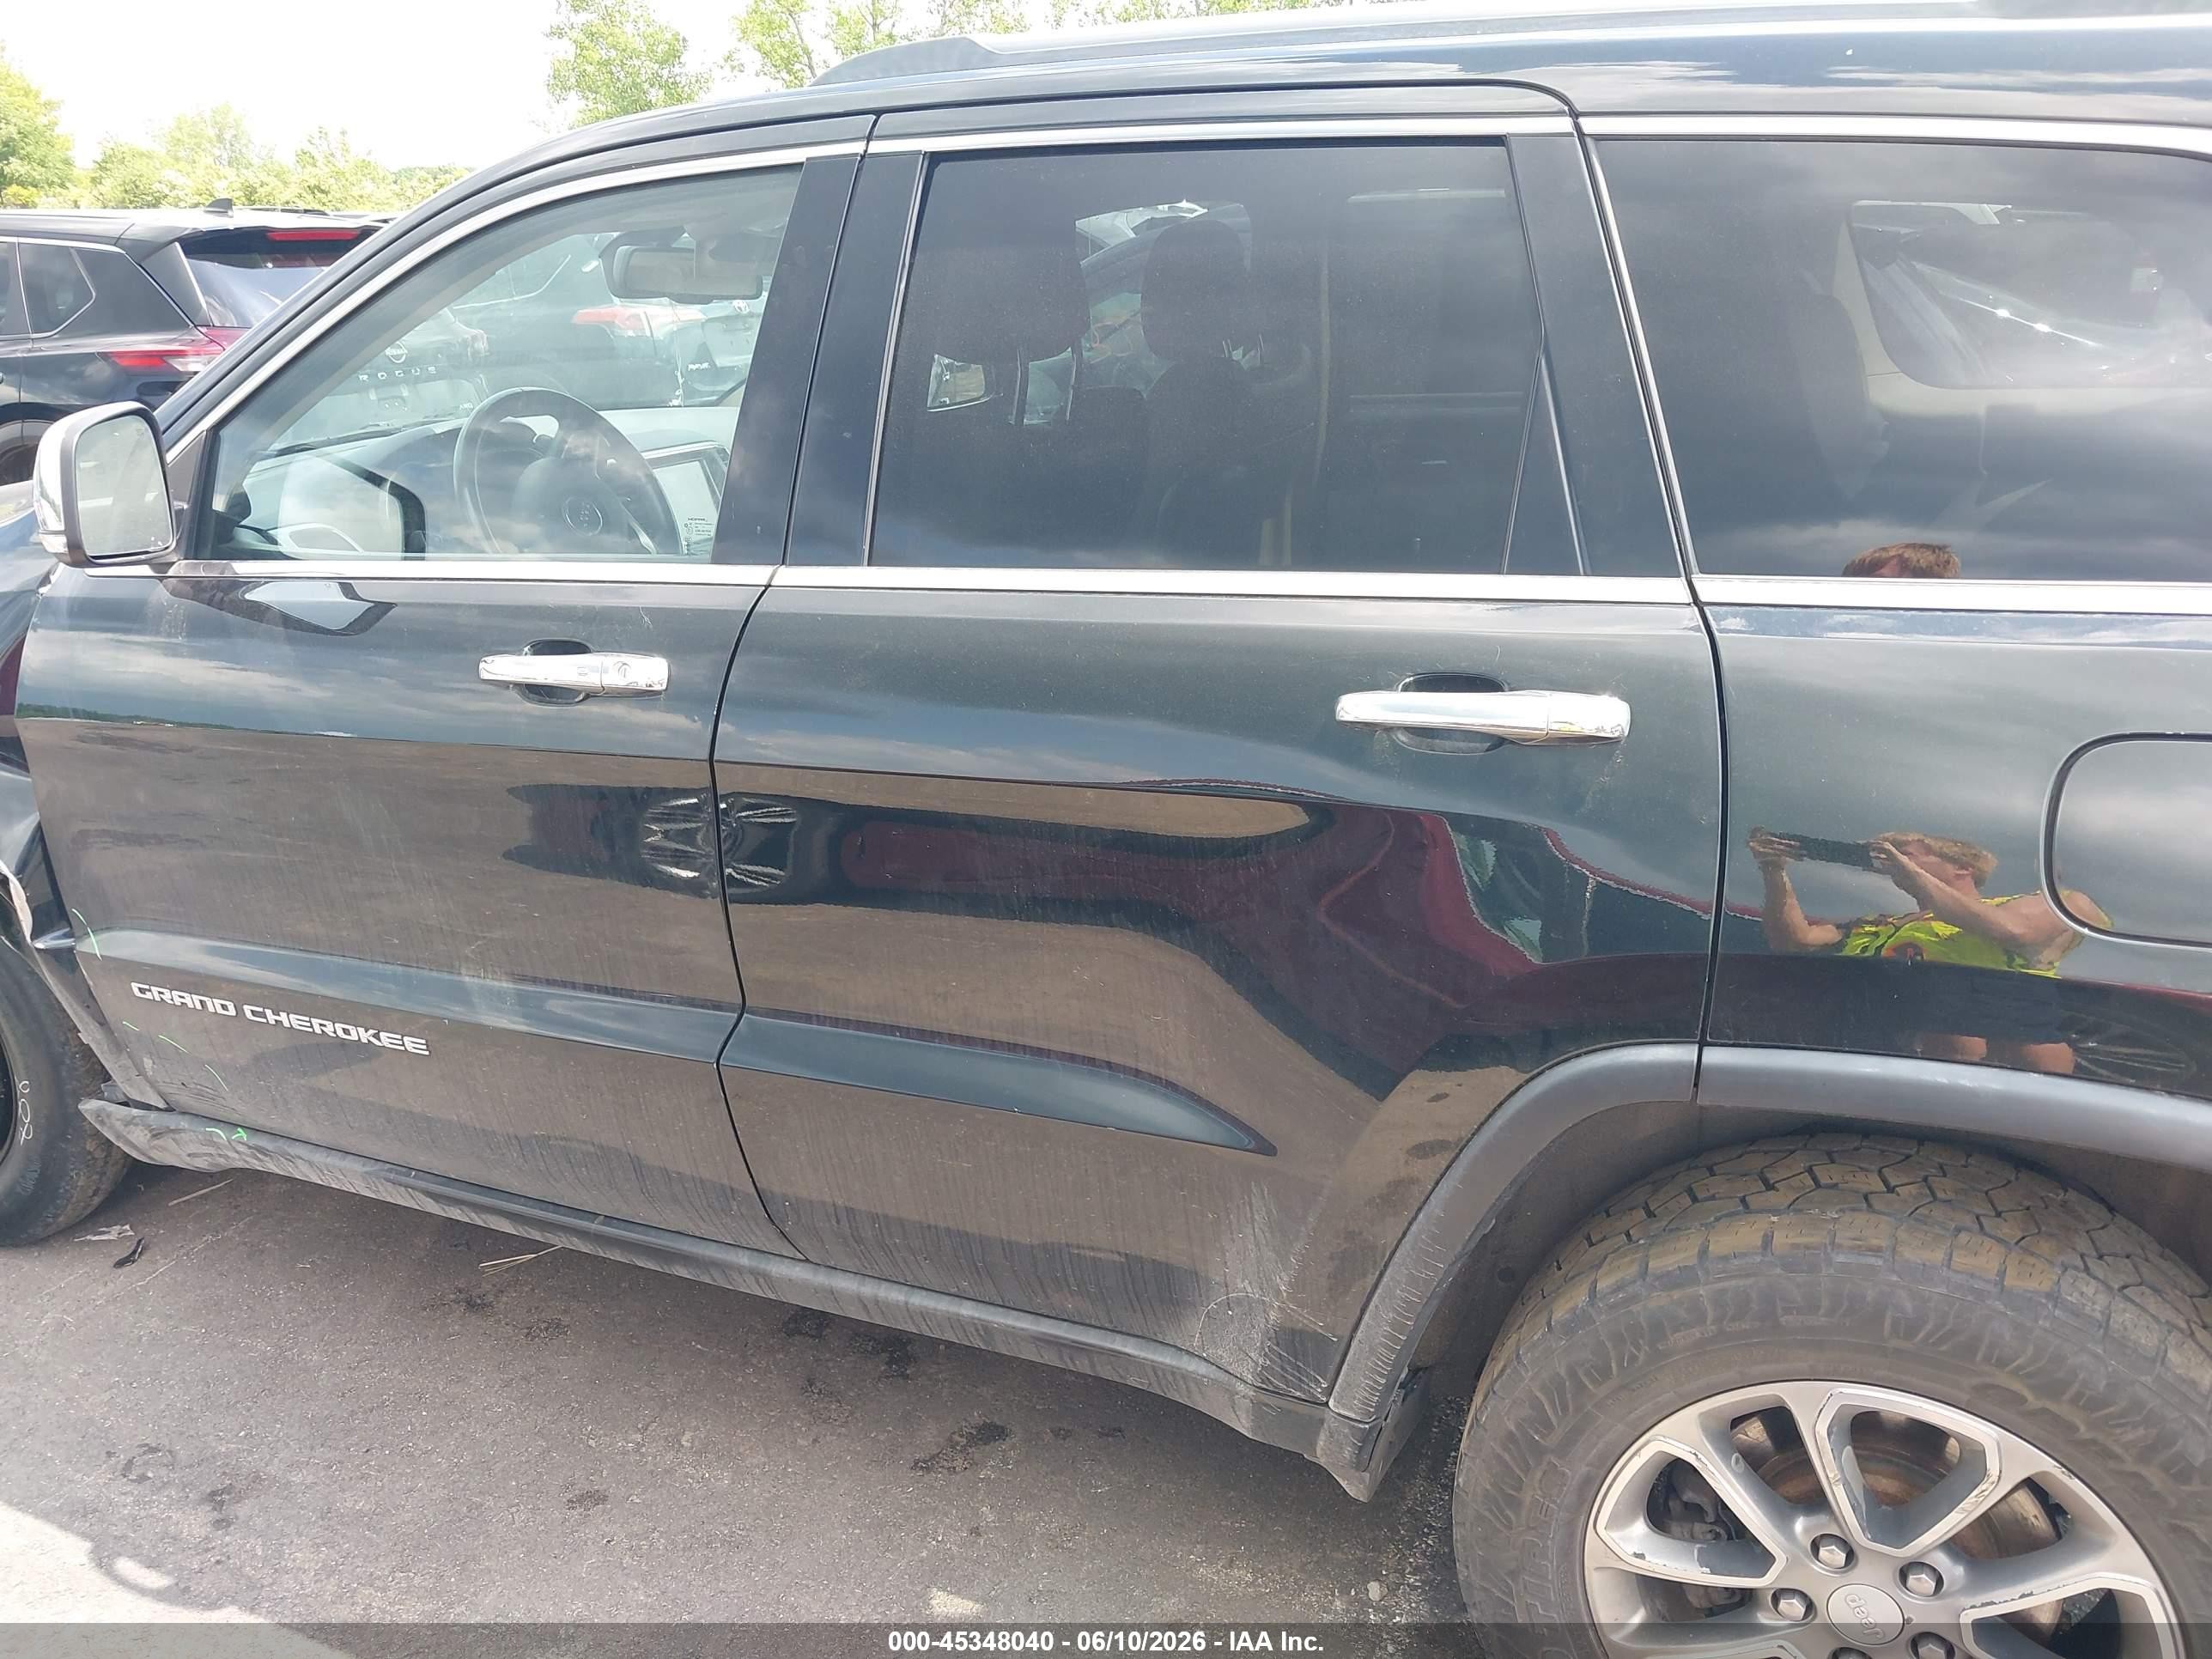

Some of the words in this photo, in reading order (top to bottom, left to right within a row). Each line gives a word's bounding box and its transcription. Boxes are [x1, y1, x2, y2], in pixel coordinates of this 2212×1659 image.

[131, 981, 238, 1018] GRAND
[243, 1004, 430, 1056] CHEROKEE
[1844, 1594, 1886, 1639] Jeep
